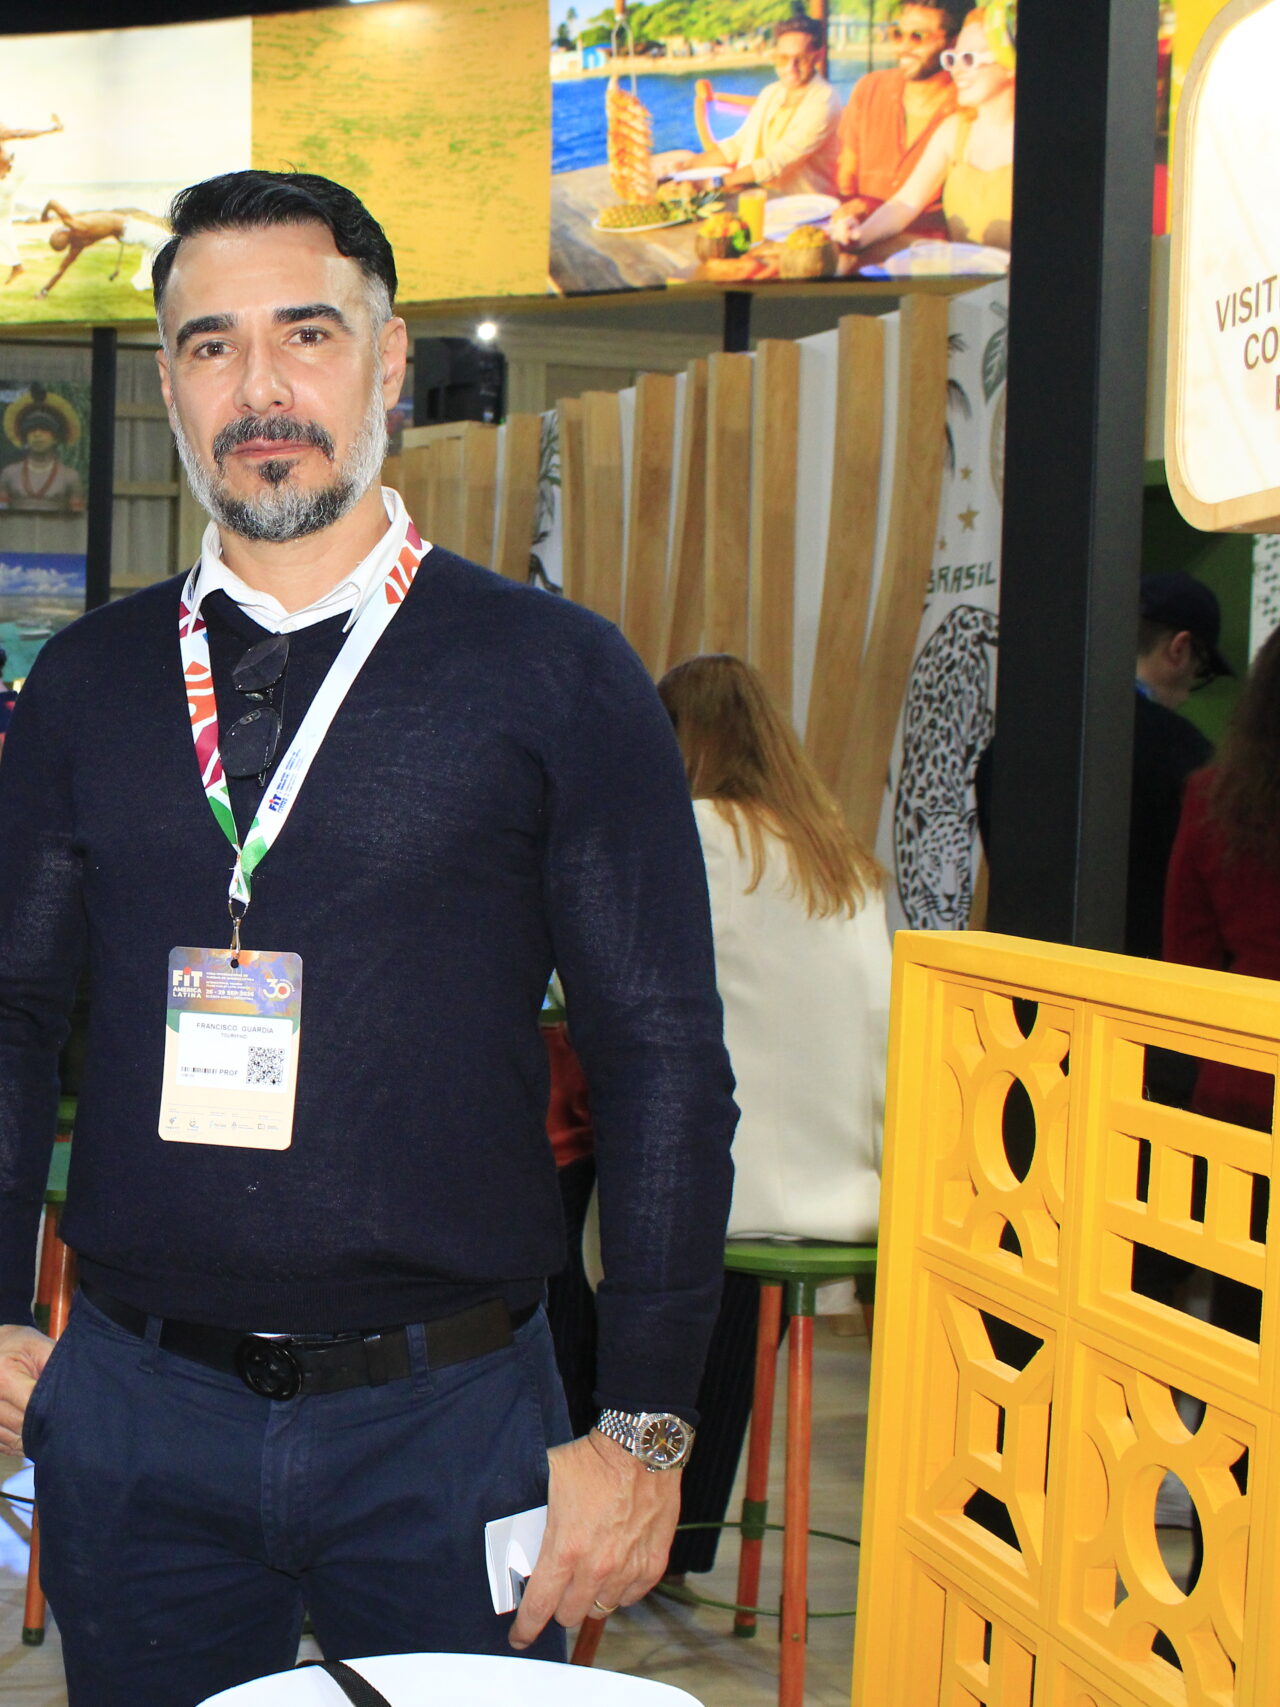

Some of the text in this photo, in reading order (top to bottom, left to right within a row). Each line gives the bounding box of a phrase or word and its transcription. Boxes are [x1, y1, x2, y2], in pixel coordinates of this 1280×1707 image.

[1215, 274, 1280, 333] VISIT
[173, 986, 202, 994] AMERICA
[173, 991, 202, 999] LATINA
[196, 1022, 274, 1034] FRANCISCO GUARDIA
